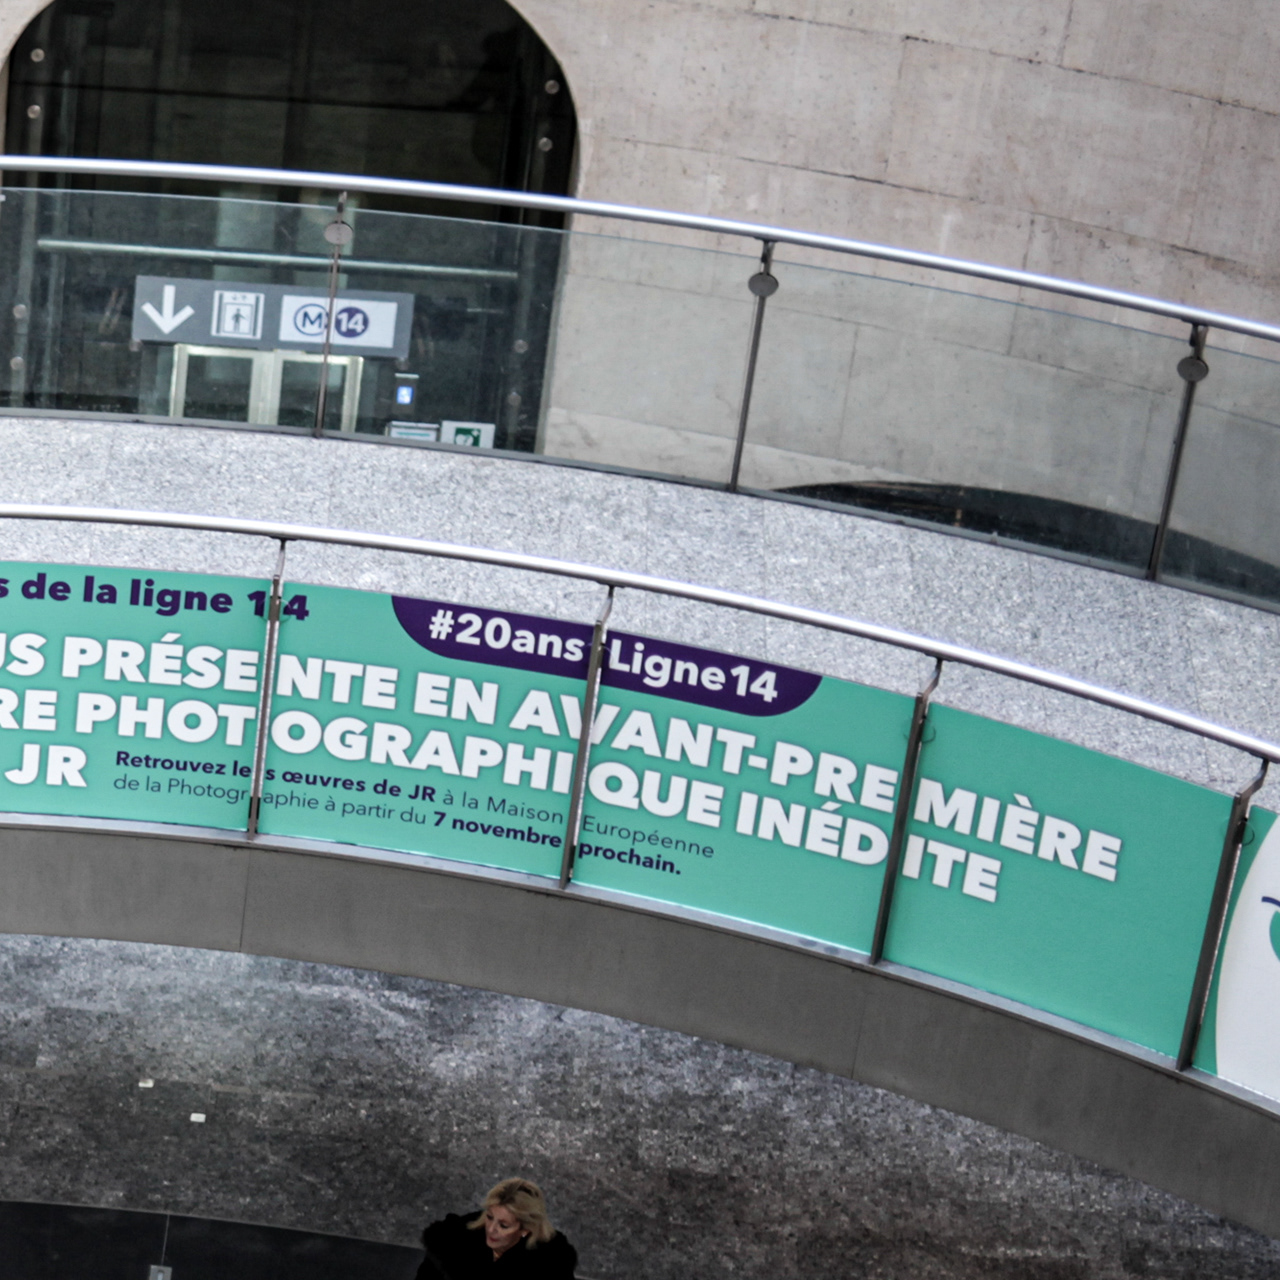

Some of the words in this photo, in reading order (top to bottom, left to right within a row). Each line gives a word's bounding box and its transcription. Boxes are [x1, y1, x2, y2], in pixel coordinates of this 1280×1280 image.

[337, 312, 365, 333] 14
[21, 572, 72, 601] de
[83, 575, 117, 604] la
[130, 578, 233, 617] ligne
[247, 590, 309, 621] 14
[4, 743, 88, 788] JR
[61, 632, 398, 710] PRÉSENTE
[413, 672, 499, 725] EN
[509, 689, 1122, 882] AVANT-PREMIÈRE
[75, 691, 725, 828] PHOTOGRAPHIQUE
[735, 791, 1002, 903] INÉDITE
[115, 750, 226, 776] Retrouvez
[232, 760, 276, 781] les
[281, 770, 366, 792] œuvres
[373, 779, 402, 798] de
[408, 784, 437, 802] JR
[442, 789, 454, 805] à
[462, 791, 479, 809] la
[487, 796, 564, 825] Maison
[582, 815, 715, 859] Européenne
[113, 773, 140, 791] de
[146, 775, 162, 793] la
[167, 777, 320, 809] Photographie
[324, 796, 336, 812] à
[341, 802, 395, 820] partir
[400, 806, 427, 825] du
[433, 811, 447, 827] 7
[451, 817, 563, 848] novembre
[577, 841, 682, 875] prochain.
